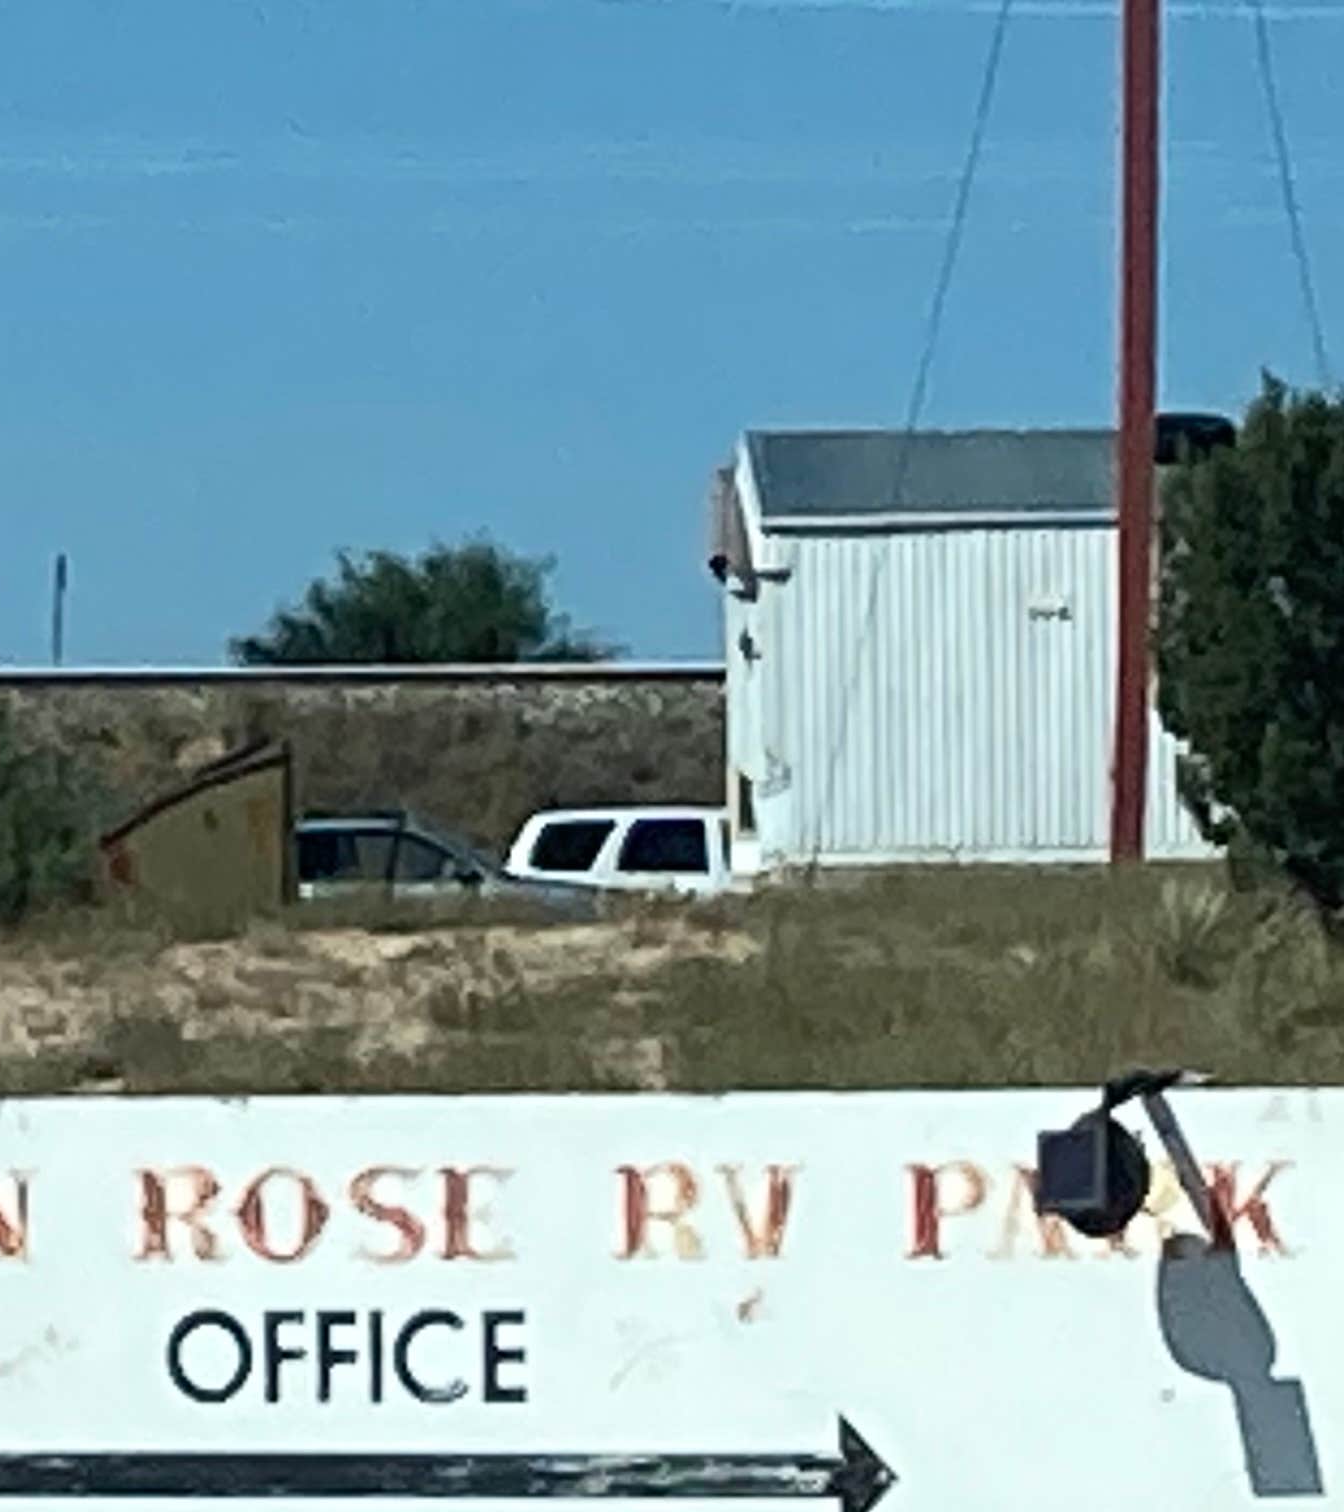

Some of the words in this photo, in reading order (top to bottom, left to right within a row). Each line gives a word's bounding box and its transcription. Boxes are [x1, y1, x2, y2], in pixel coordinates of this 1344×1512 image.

[130, 1163, 519, 1264] ROSE
[613, 1161, 805, 1263] RV
[165, 1307, 531, 1406] OFFICE
